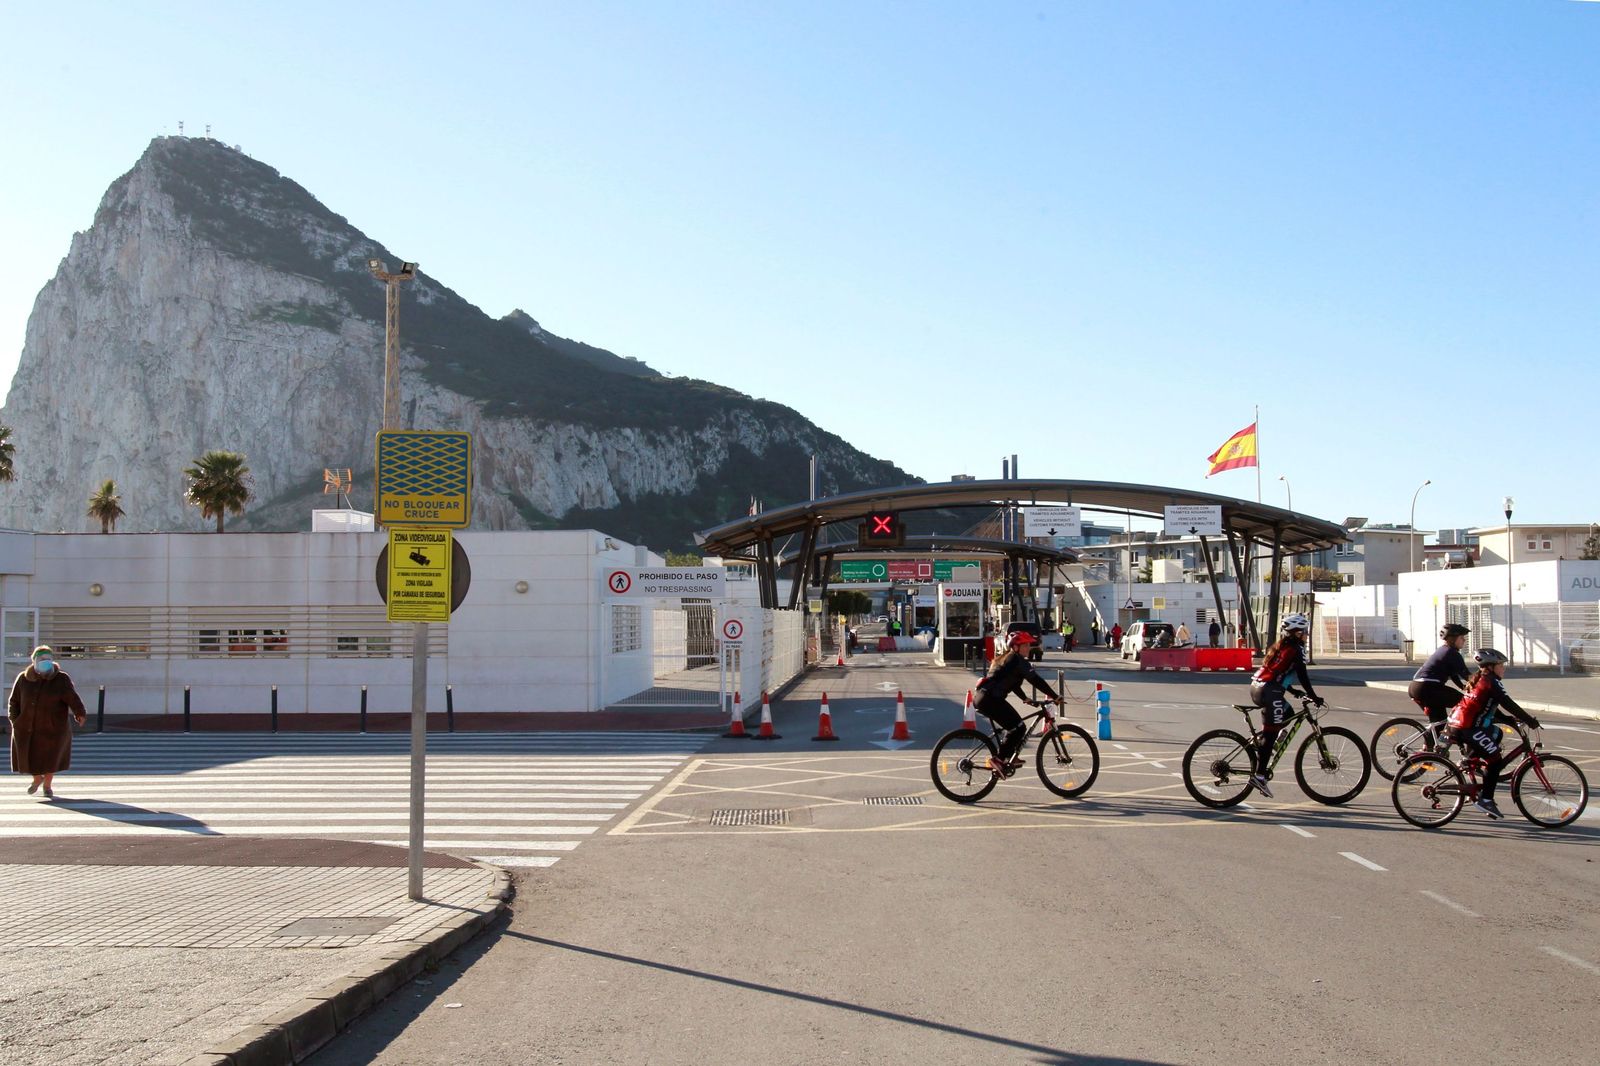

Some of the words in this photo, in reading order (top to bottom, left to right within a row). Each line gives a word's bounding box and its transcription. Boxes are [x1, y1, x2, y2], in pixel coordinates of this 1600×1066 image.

[384, 500, 399, 508] NO
[404, 500, 460, 509] BLOQUEAR
[404, 510, 439, 518] CRUCE
[394, 534, 408, 542] ZONA
[409, 534, 446, 542] VIDEOVIGILADA
[1572, 577, 1600, 588] ADU
[952, 588, 981, 597] ADUANA
[1272, 700, 1283, 724] UCM
[1472, 730, 1498, 754] UCM
